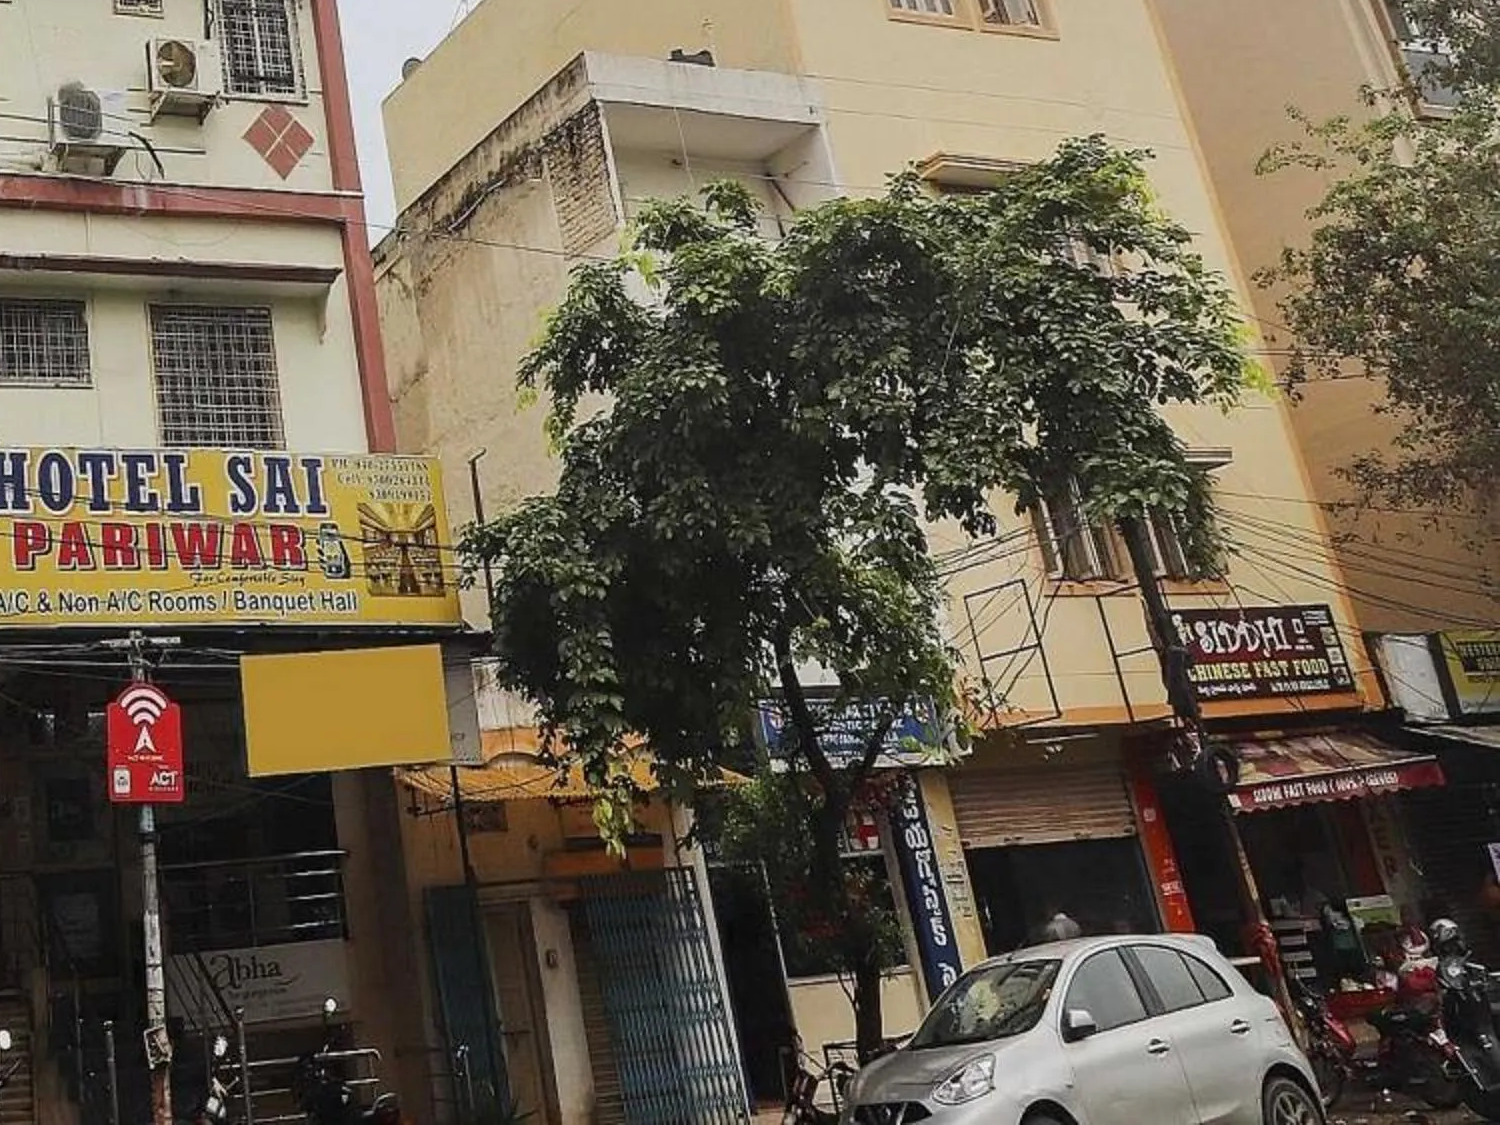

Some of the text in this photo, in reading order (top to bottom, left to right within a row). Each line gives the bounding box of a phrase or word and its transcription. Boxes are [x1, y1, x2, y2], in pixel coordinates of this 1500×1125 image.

[227, 454, 328, 515] SAI
[12, 520, 308, 571] PARIWAR
[37, 591, 53, 613] &
[149, 591, 217, 612] Rooms
[233, 590, 316, 617] Banquet
[321, 590, 357, 611] Hall
[1187, 658, 1330, 683] CHINESE FAST FOOD
[149, 770, 179, 786] ACT
